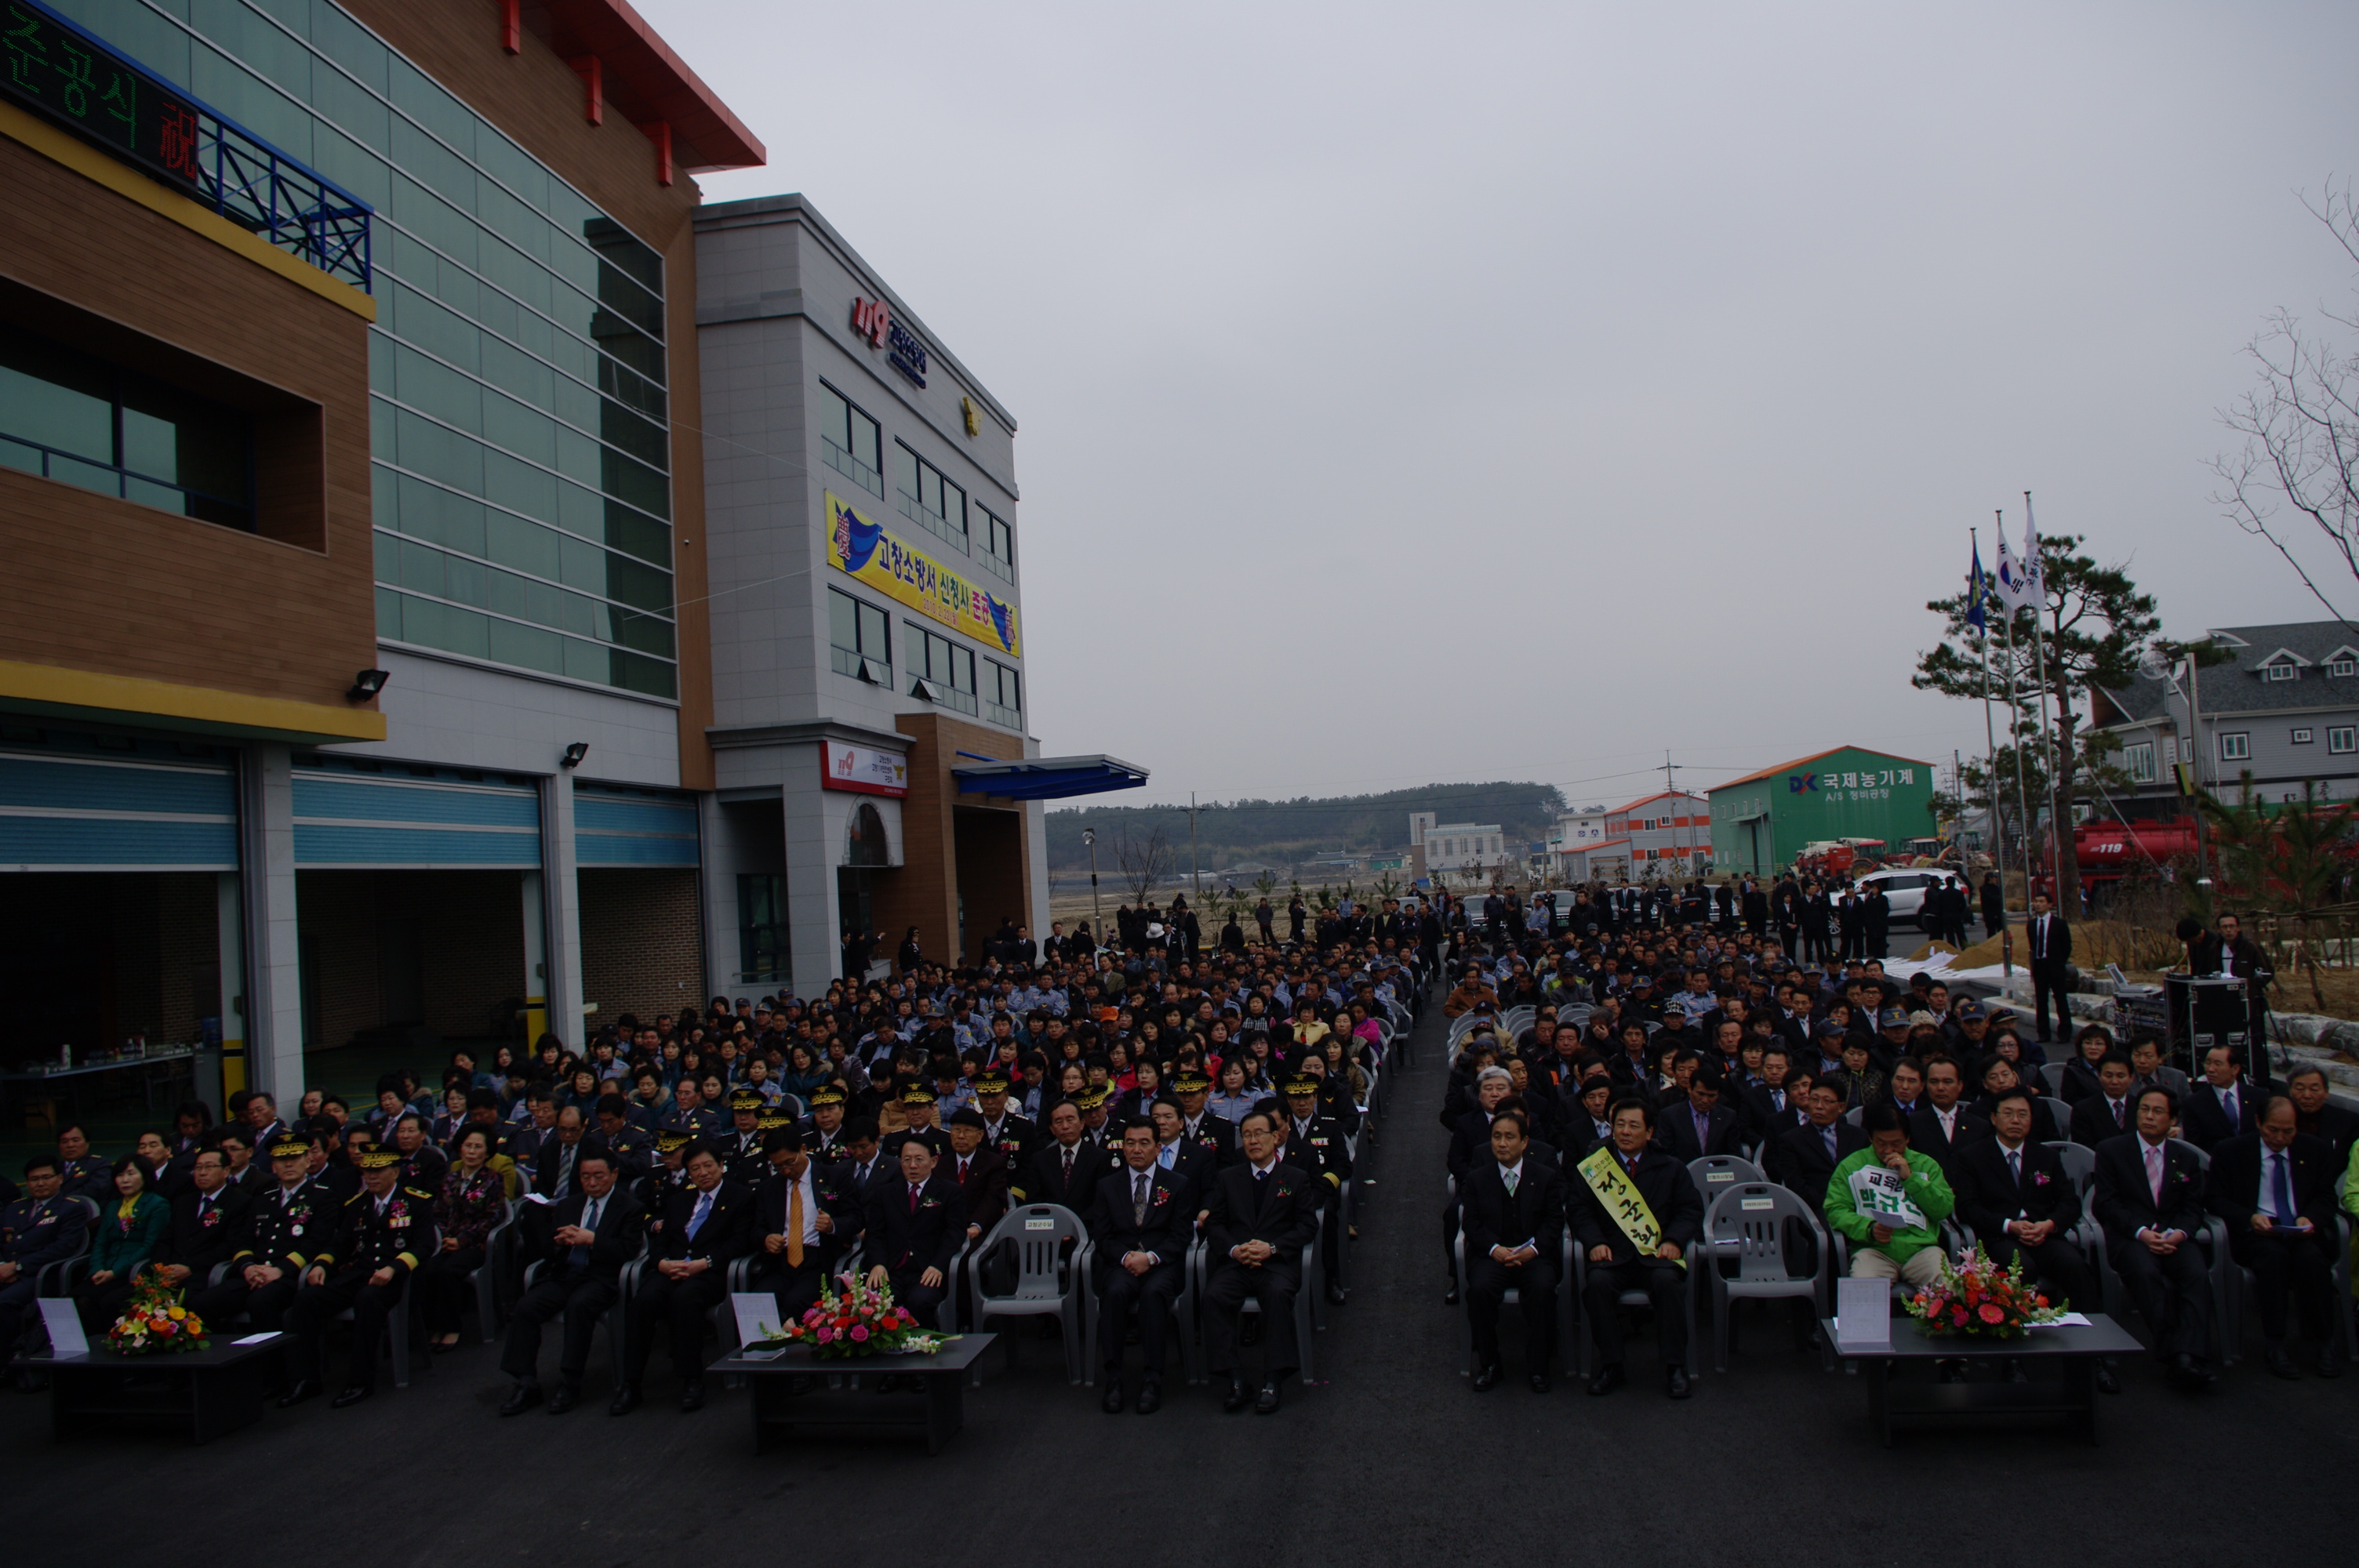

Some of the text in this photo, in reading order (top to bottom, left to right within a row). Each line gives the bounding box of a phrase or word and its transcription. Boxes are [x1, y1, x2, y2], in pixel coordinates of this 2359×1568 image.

[2, 6, 196, 180] 준공식 祝
[853, 296, 889, 349] 119
[879, 533, 990, 626] 고창소방서 신청사 준공
[838, 751, 854, 776] 119
[1823, 768, 1914, 789] 국제농기계
[1826, 789, 1889, 801] A/S 정비공장
[2100, 843, 2123, 853] 119
